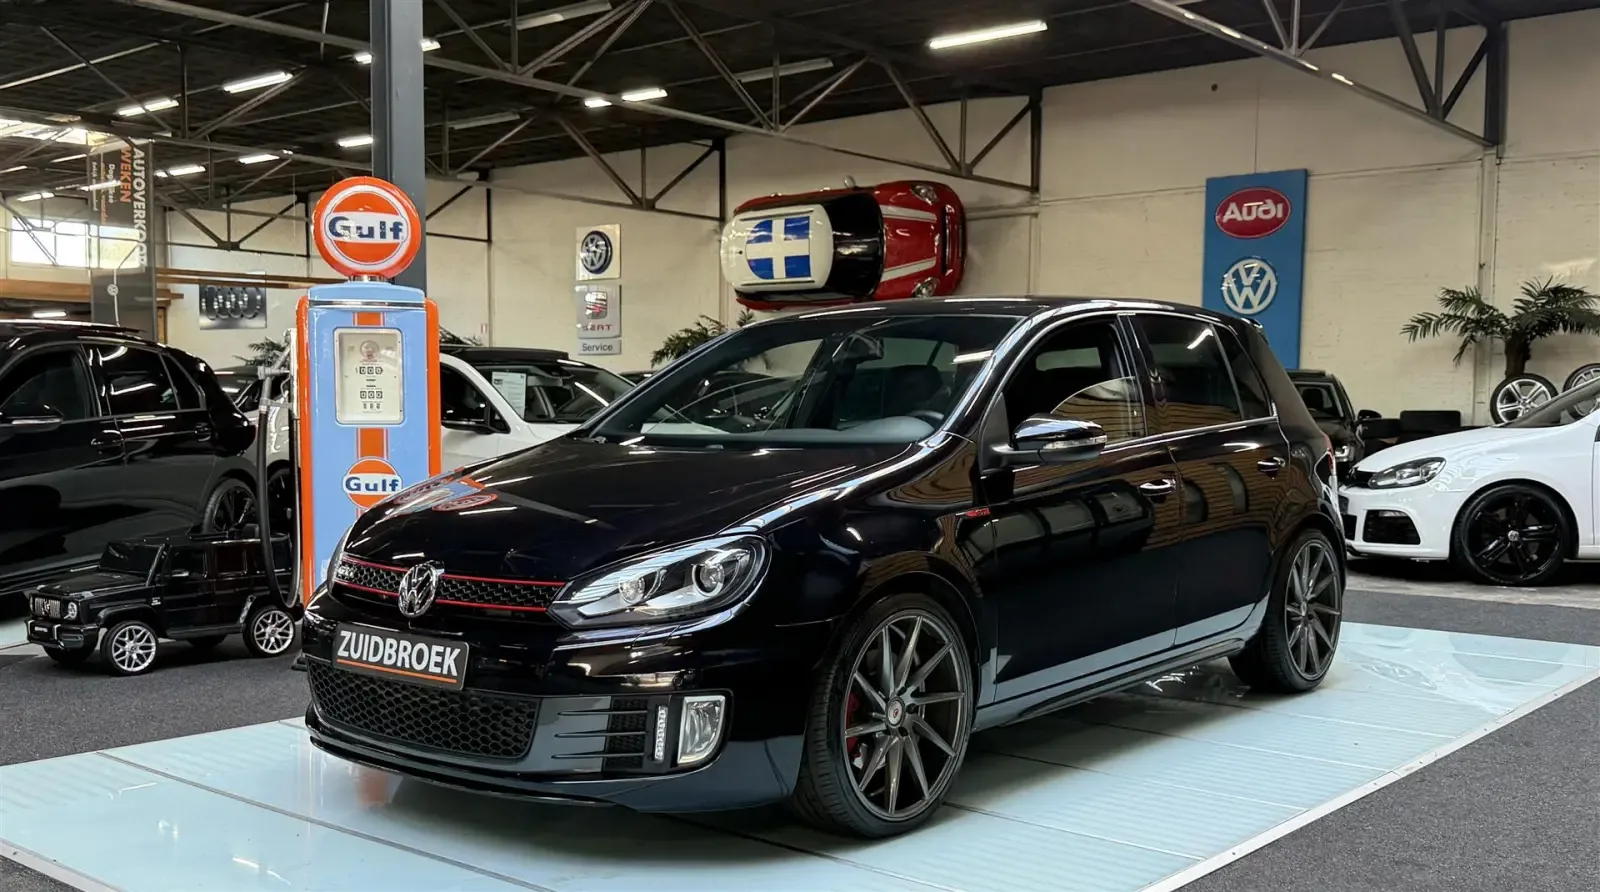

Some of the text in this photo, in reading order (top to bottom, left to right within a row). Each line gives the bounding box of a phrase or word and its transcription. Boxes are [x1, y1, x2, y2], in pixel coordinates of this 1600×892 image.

[120, 147, 131, 203] WEKEN
[328, 216, 403, 240] Gulf
[582, 343, 613, 352] Service
[345, 476, 399, 492] Gulf
[337, 630, 461, 677] ZUIDBROEK
